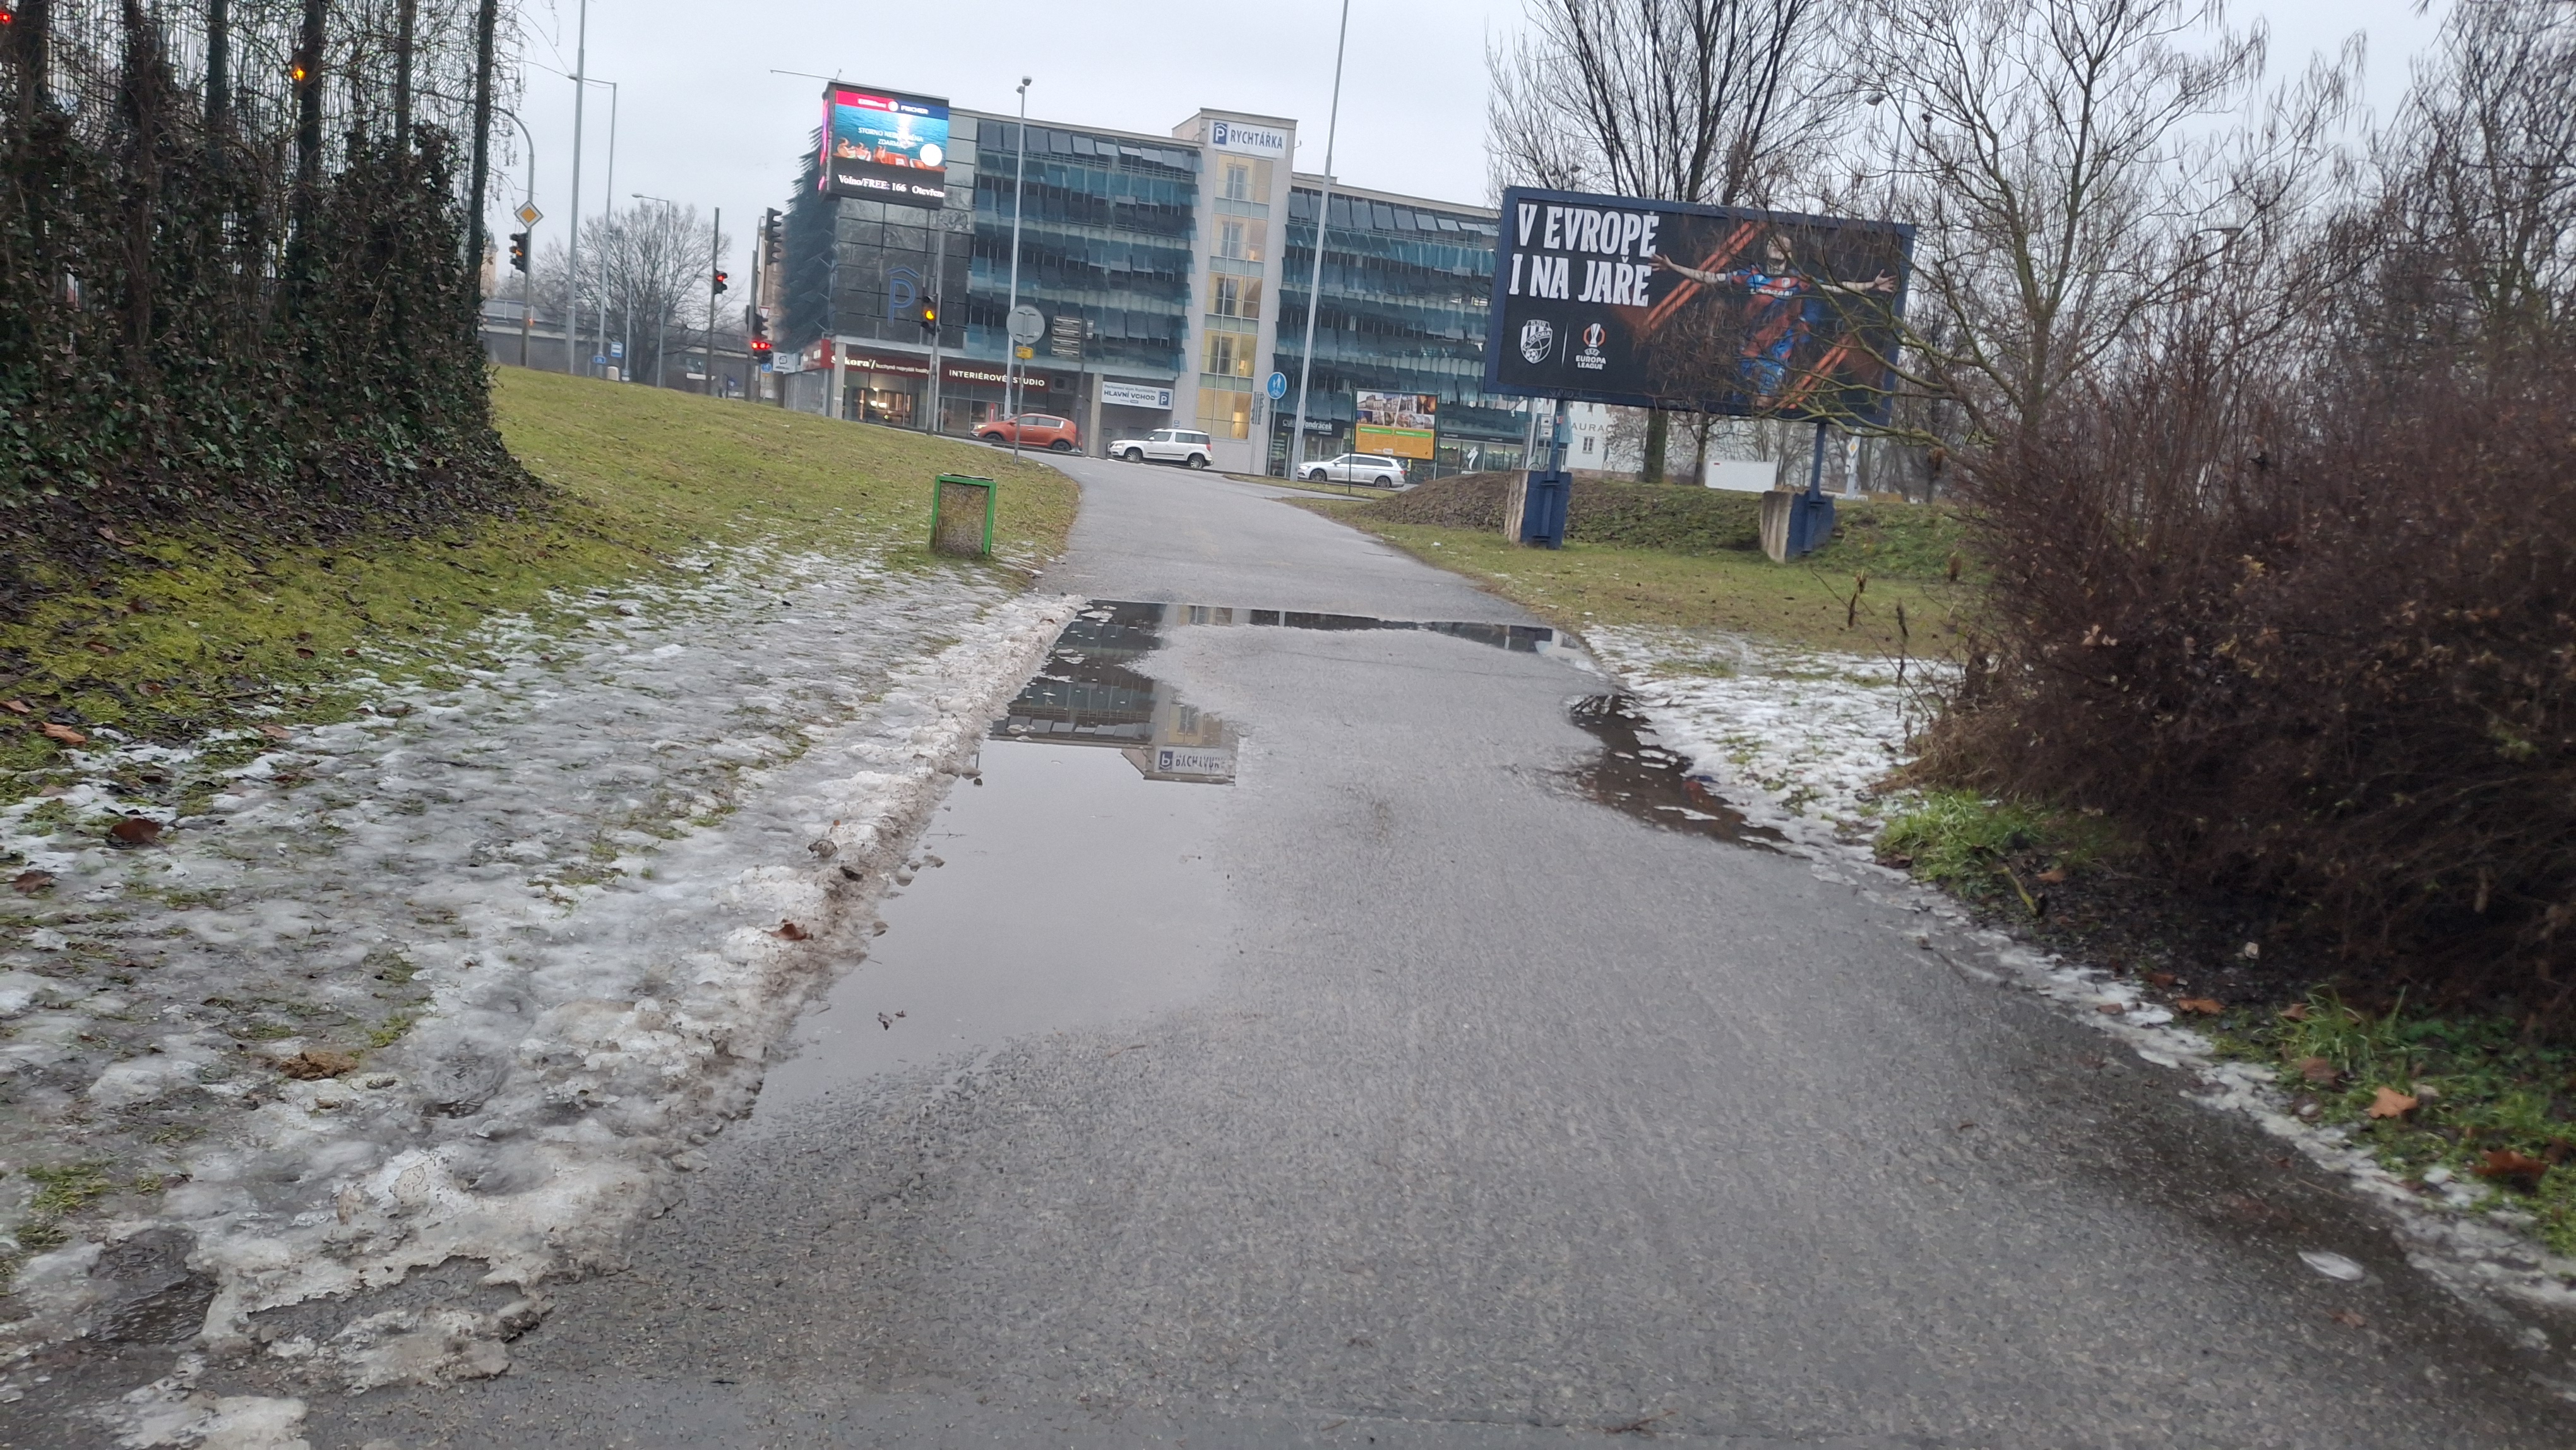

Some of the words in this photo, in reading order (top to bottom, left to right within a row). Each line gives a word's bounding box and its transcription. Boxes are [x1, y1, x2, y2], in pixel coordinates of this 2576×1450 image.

[1230, 129, 1282, 149] RYCHTÁŘKA
[891, 183, 907, 192] 166
[1518, 203, 1538, 246] V
[1543, 205, 1660, 258] EVROPĚ
[1508, 253, 1524, 295] I
[1529, 255, 1570, 300] NA
[1578, 256, 1652, 307] JAŘE
[1575, 355, 1606, 364] EUROPA
[949, 369, 1008, 383] INTERIÉROVÉ
[1104, 390, 1130, 398] HLAVNÍ
